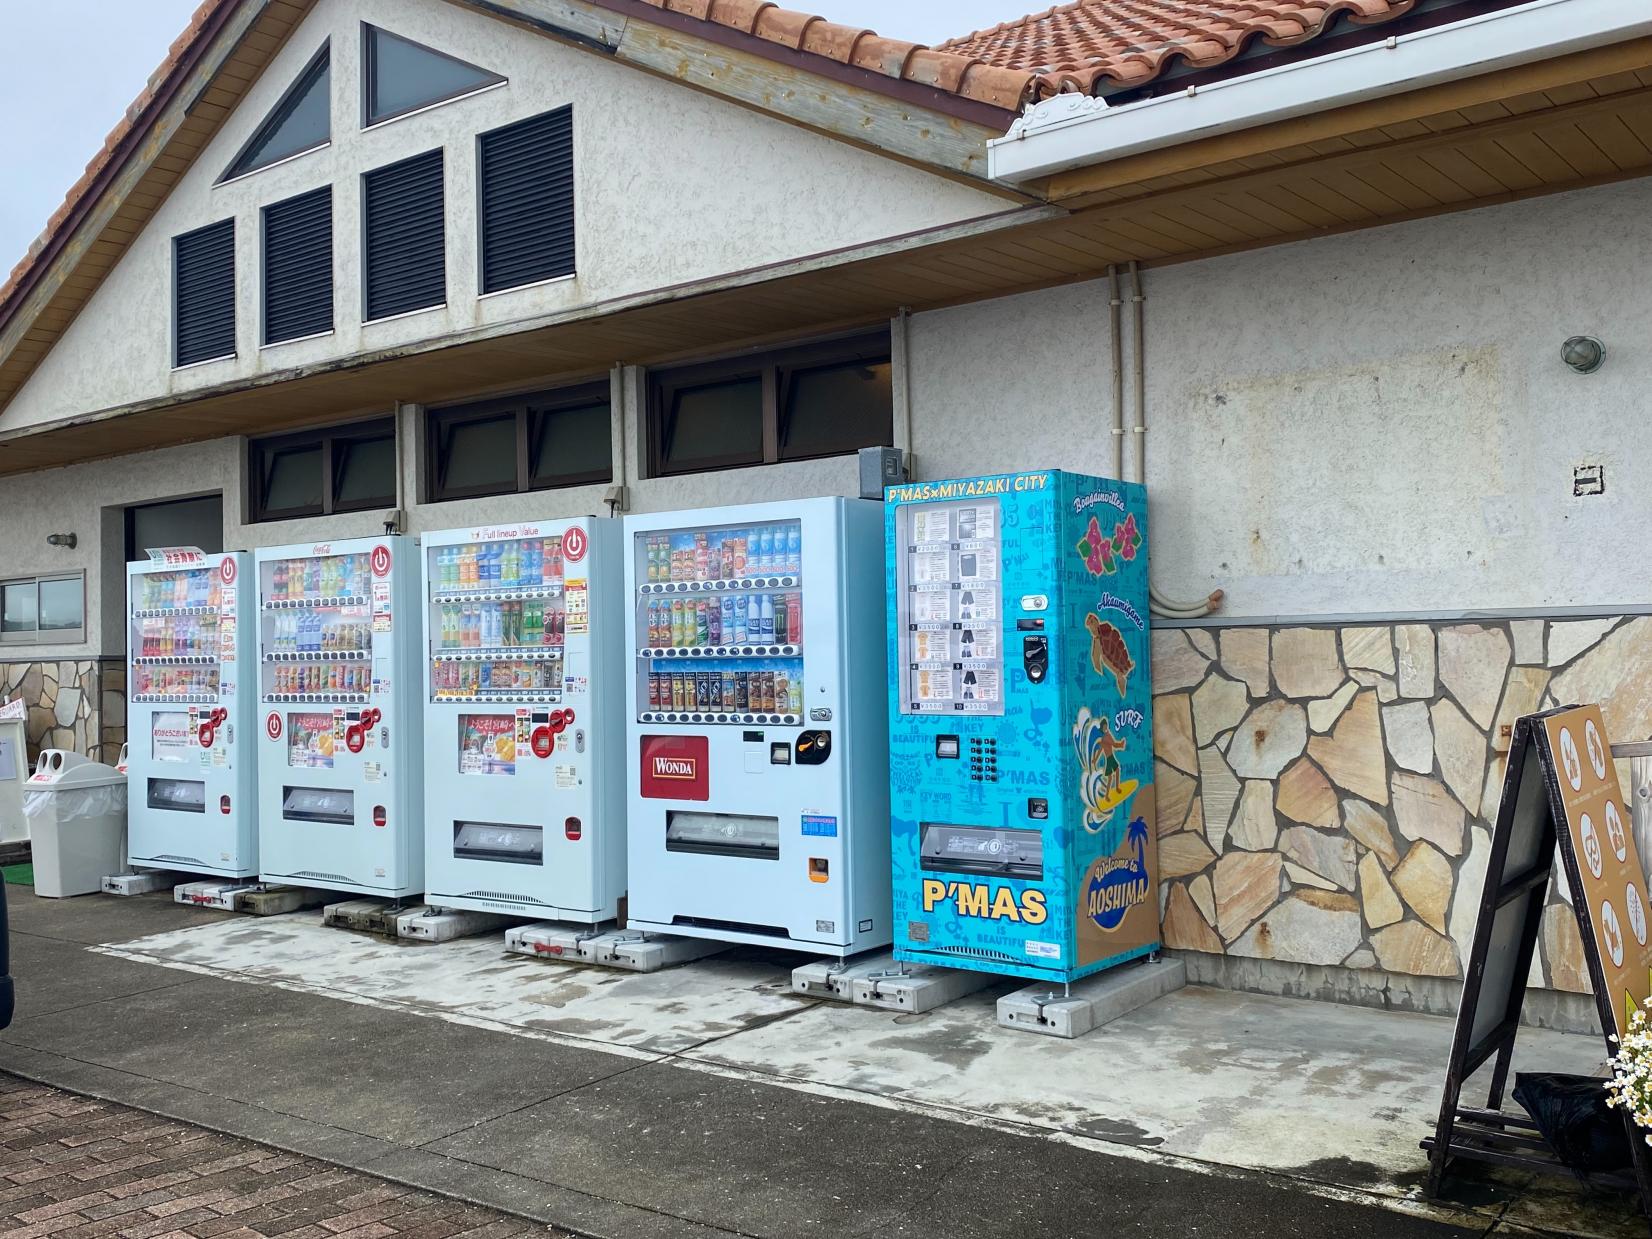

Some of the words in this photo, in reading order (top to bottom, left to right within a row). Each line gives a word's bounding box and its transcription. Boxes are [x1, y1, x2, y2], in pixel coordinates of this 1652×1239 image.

[1014, 474, 1047, 491] CITY
[482, 528, 496, 539] Full
[497, 528, 518, 539] lineup
[520, 525, 539, 536] Value
[1115, 709, 1143, 731] SURF
[655, 757, 693, 775] WONDA
[1095, 856, 1128, 882] Welcome
[1129, 857, 1139, 873] to
[922, 878, 1048, 925] P'MAS
[1087, 878, 1146, 918] AOSHIMA
